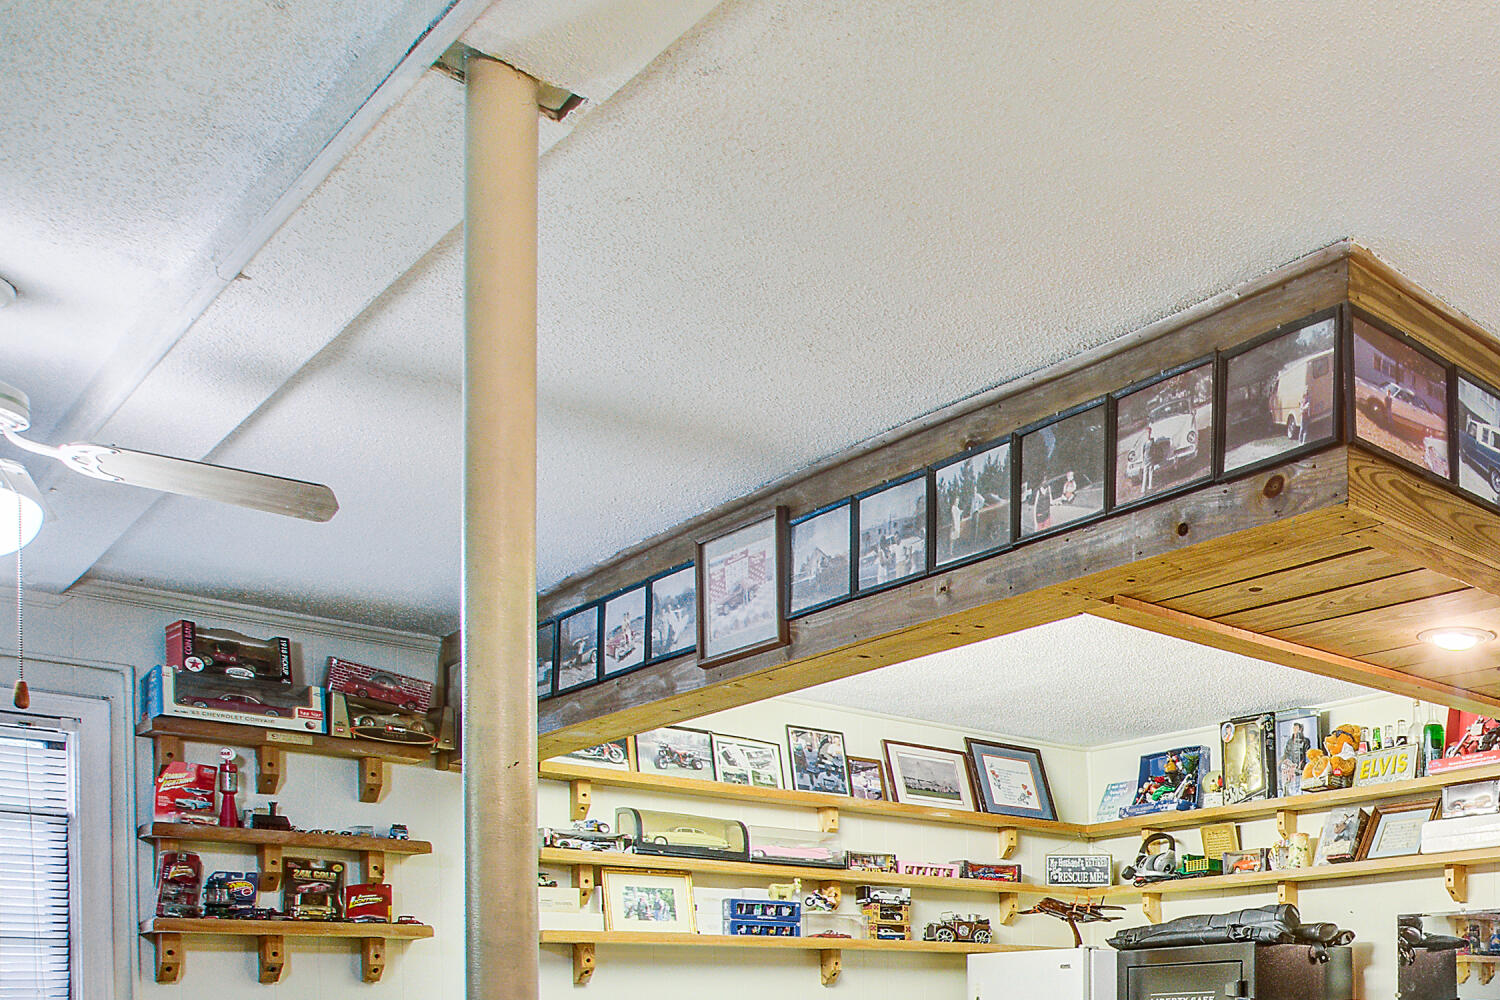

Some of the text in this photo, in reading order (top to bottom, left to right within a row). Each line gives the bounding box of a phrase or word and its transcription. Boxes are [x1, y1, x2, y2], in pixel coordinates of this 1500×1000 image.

[279, 639, 289, 676] 1918 PICKUP
[202, 711, 243, 720] CHEVROLET
[245, 716, 275, 724] CORVAIR
[1360, 753, 1408, 779] ELVIS
[313, 870, 337, 880] GOLD
[1058, 871, 1088, 882] RESCUE
